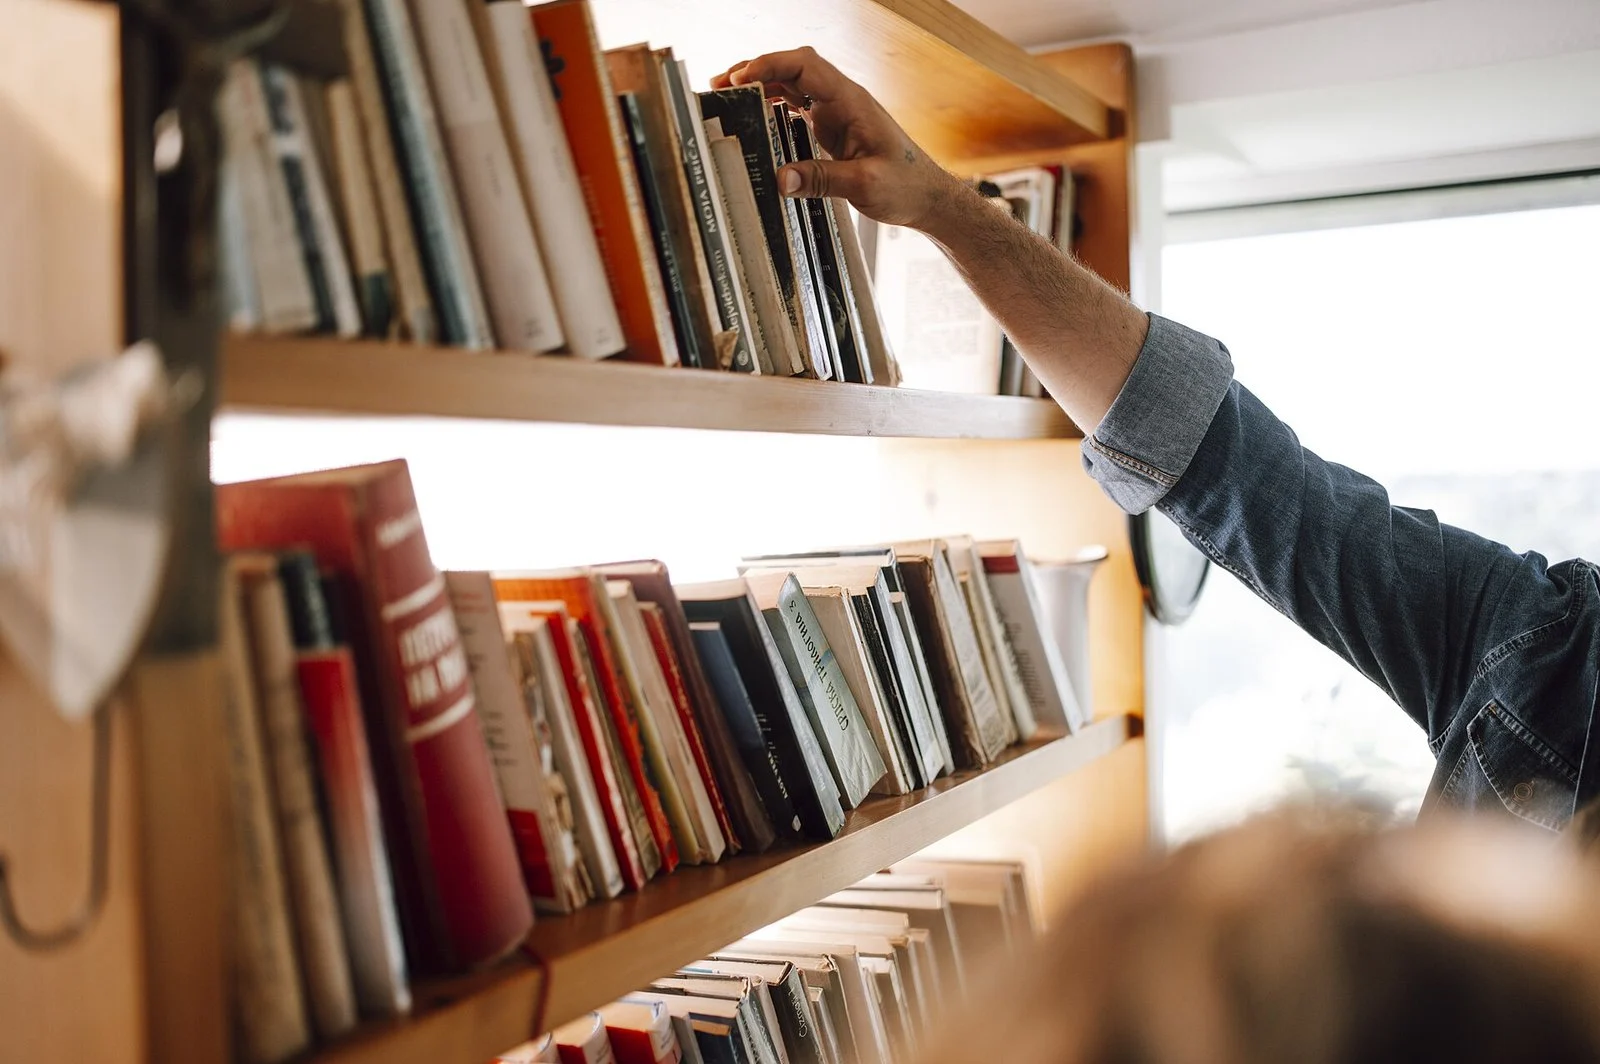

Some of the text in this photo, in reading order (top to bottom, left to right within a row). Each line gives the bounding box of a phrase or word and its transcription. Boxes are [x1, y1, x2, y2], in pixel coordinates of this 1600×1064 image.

[686, 137, 706, 186] PRIČA
[789, 600, 796, 612] 3
[795, 612, 827, 684] ТРИЛОГИЈА
[825, 681, 849, 731] СРПСКА
[768, 752, 788, 799] ALOE VERA
